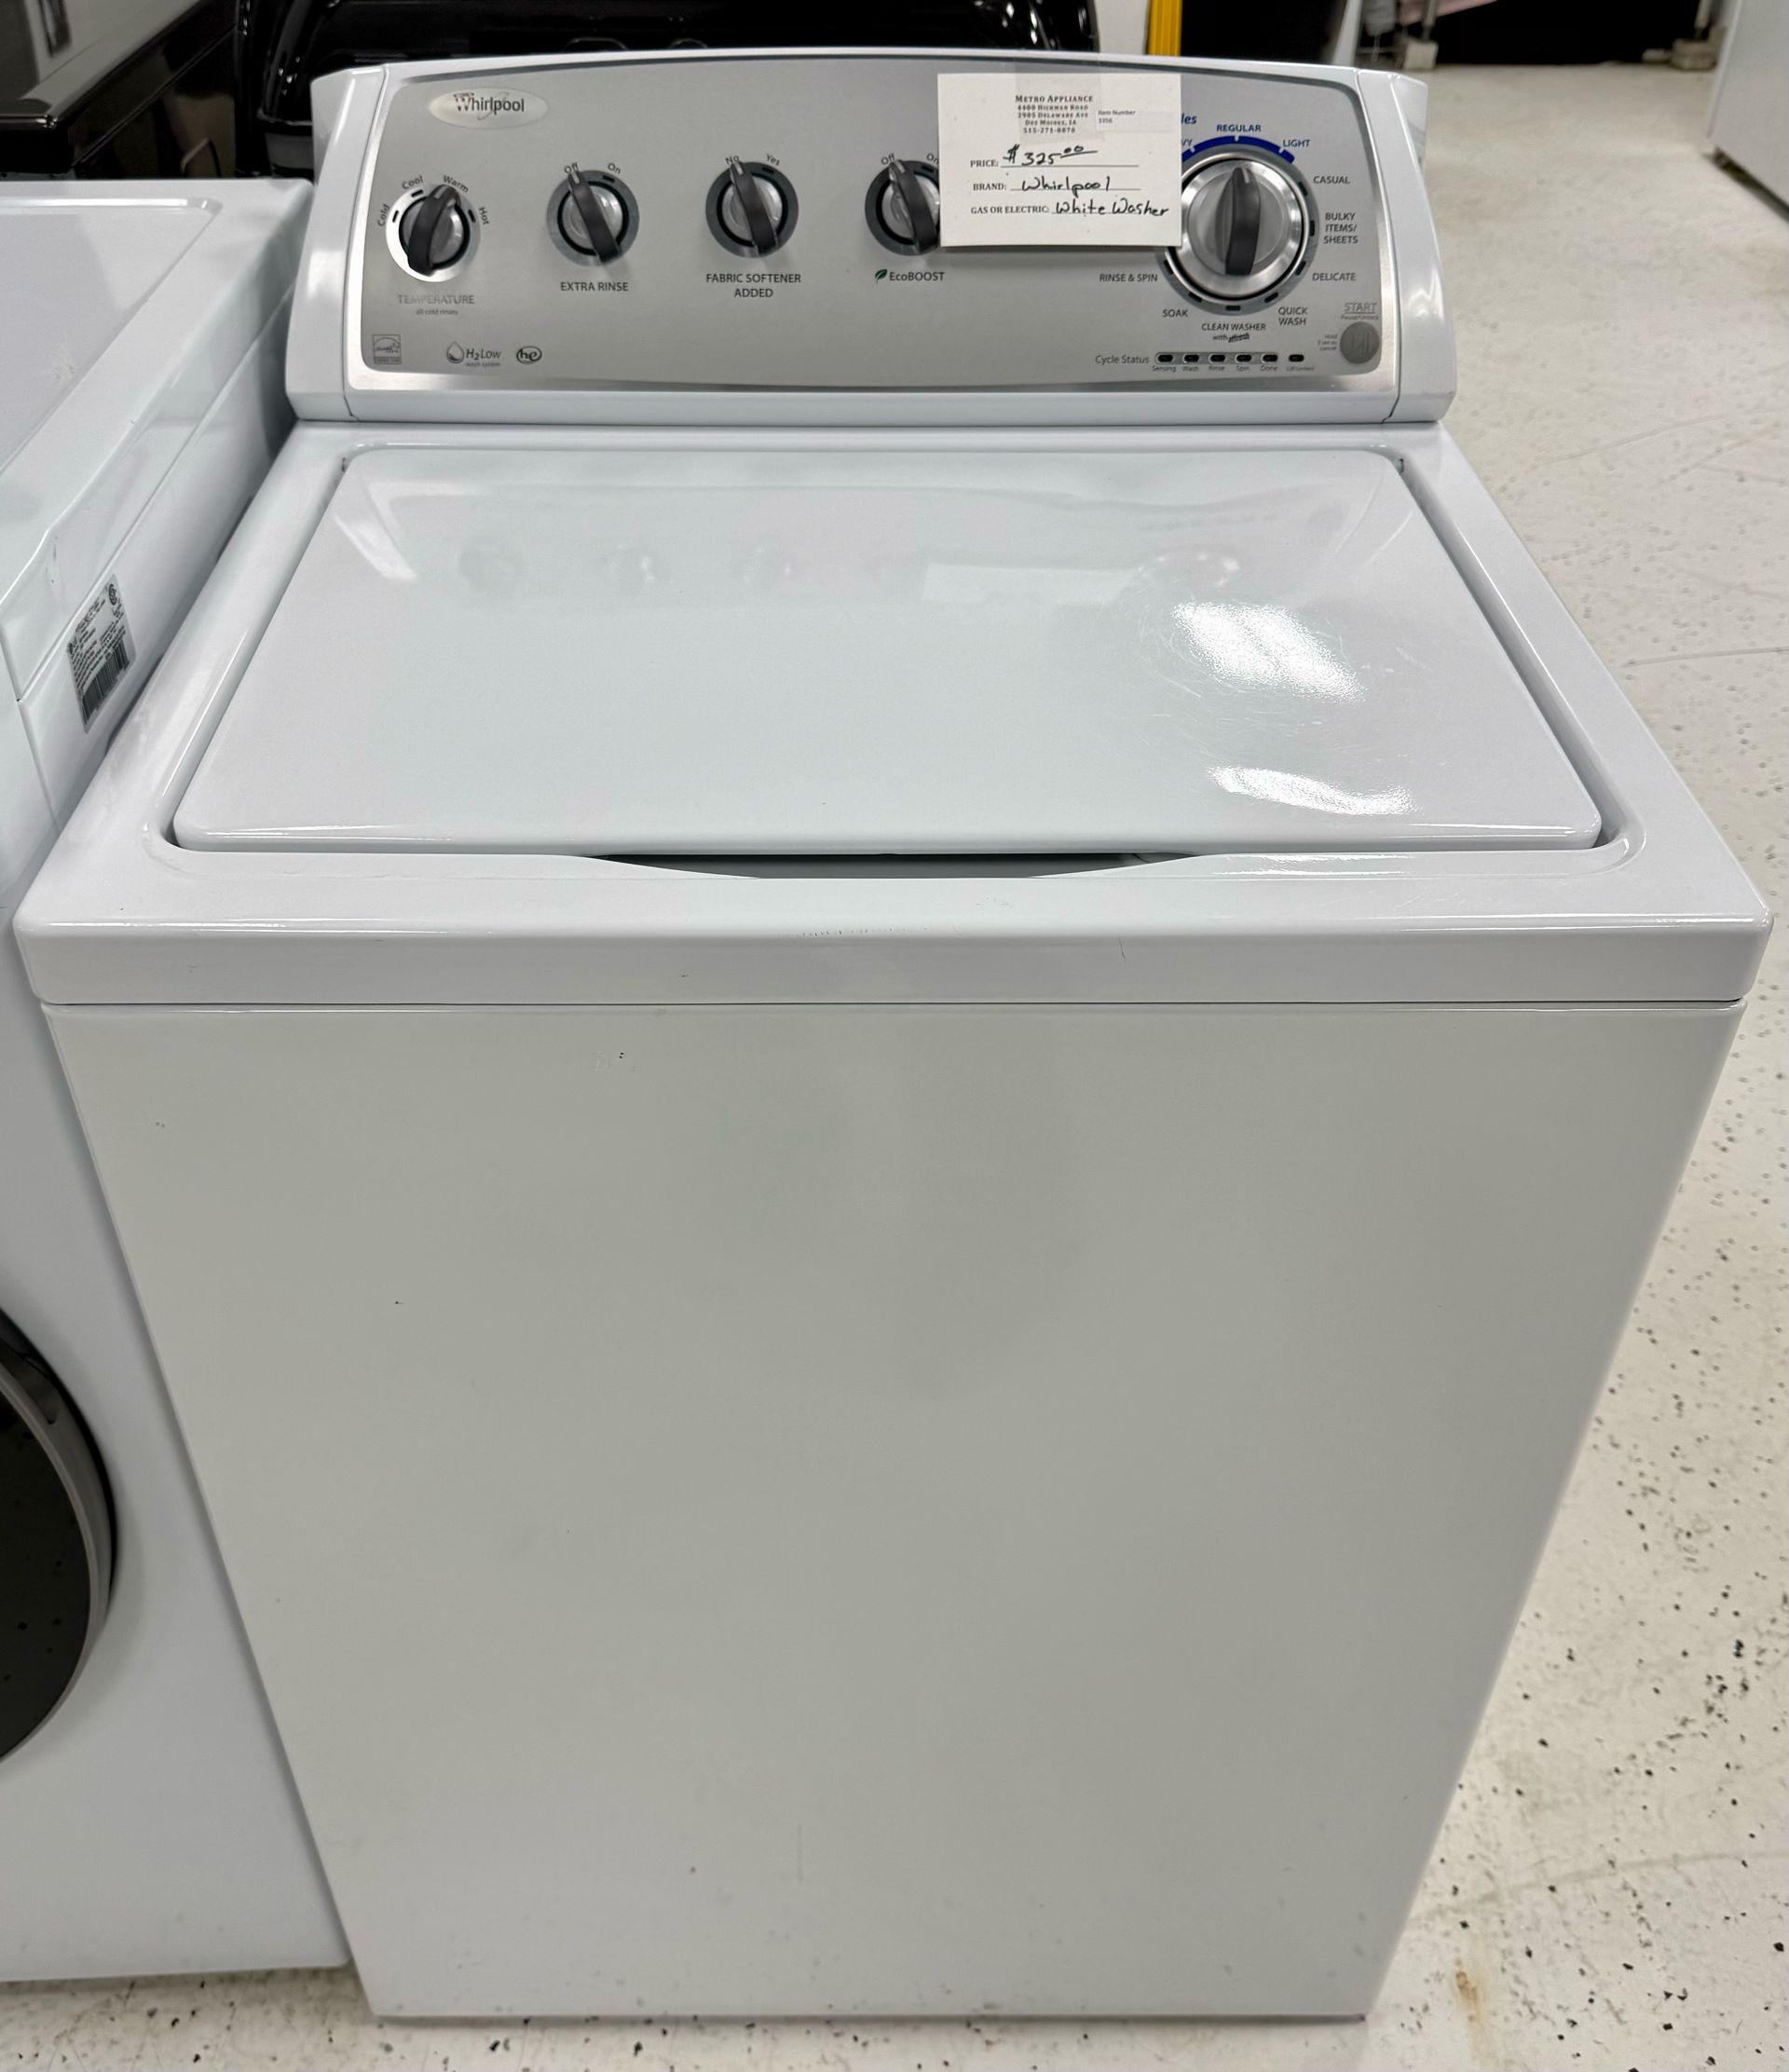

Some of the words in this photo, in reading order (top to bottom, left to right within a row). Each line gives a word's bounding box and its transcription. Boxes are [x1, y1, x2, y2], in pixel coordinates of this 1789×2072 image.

[453, 92, 526, 116] Whirlpool
[1216, 124, 1262, 133] REGULAR
[1282, 139, 1311, 148] LIGHT
[725, 156, 740, 165] No
[765, 154, 781, 167] Yes
[881, 154, 896, 166] Off
[970, 159, 999, 169] PRICE:
[607, 162, 621, 174] On
[402, 175, 424, 190] Cool
[443, 174, 470, 193] Warm
[1313, 175, 1350, 184] CASUAL
[973, 183, 1007, 191] BRAND:
[1022, 176, 1111, 198] Whirlpool
[971, 206, 989, 214] GAS
[990, 206, 1003, 214] OR
[1056, 198, 1106, 215] White
[1112, 197, 1169, 217] Washer
[376, 203, 390, 227] Cold
[478, 206, 490, 225] Hot
[1325, 212, 1356, 222] BULKY
[1325, 224, 1357, 233] ITEMS/
[1323, 235, 1359, 244] SHEETS
[705, 273, 744, 283] FABRIC
[745, 273, 801, 283] SOFTENER
[889, 270, 946, 281] EcoBOOST
[1099, 273, 1125, 282] RINSE
[1127, 273, 1135, 282] &
[1137, 273, 1158, 282] SPIN
[1312, 272, 1357, 281] DELICATE
[560, 281, 594, 292] EXTRA
[597, 281, 629, 292] RINSE
[733, 288, 773, 298] ADDED
[398, 294, 475, 305] TEMPERATURE
[1278, 307, 1308, 316] QUICK
[1344, 303, 1378, 312] START
[1162, 308, 1189, 318] SOAK
[1278, 317, 1306, 326] WASH
[1201, 323, 1229, 332] CLEAN
[1230, 323, 1266, 332] WASHER
[1095, 354, 1118, 365] Cycle
[1121, 355, 1149, 364] Status
